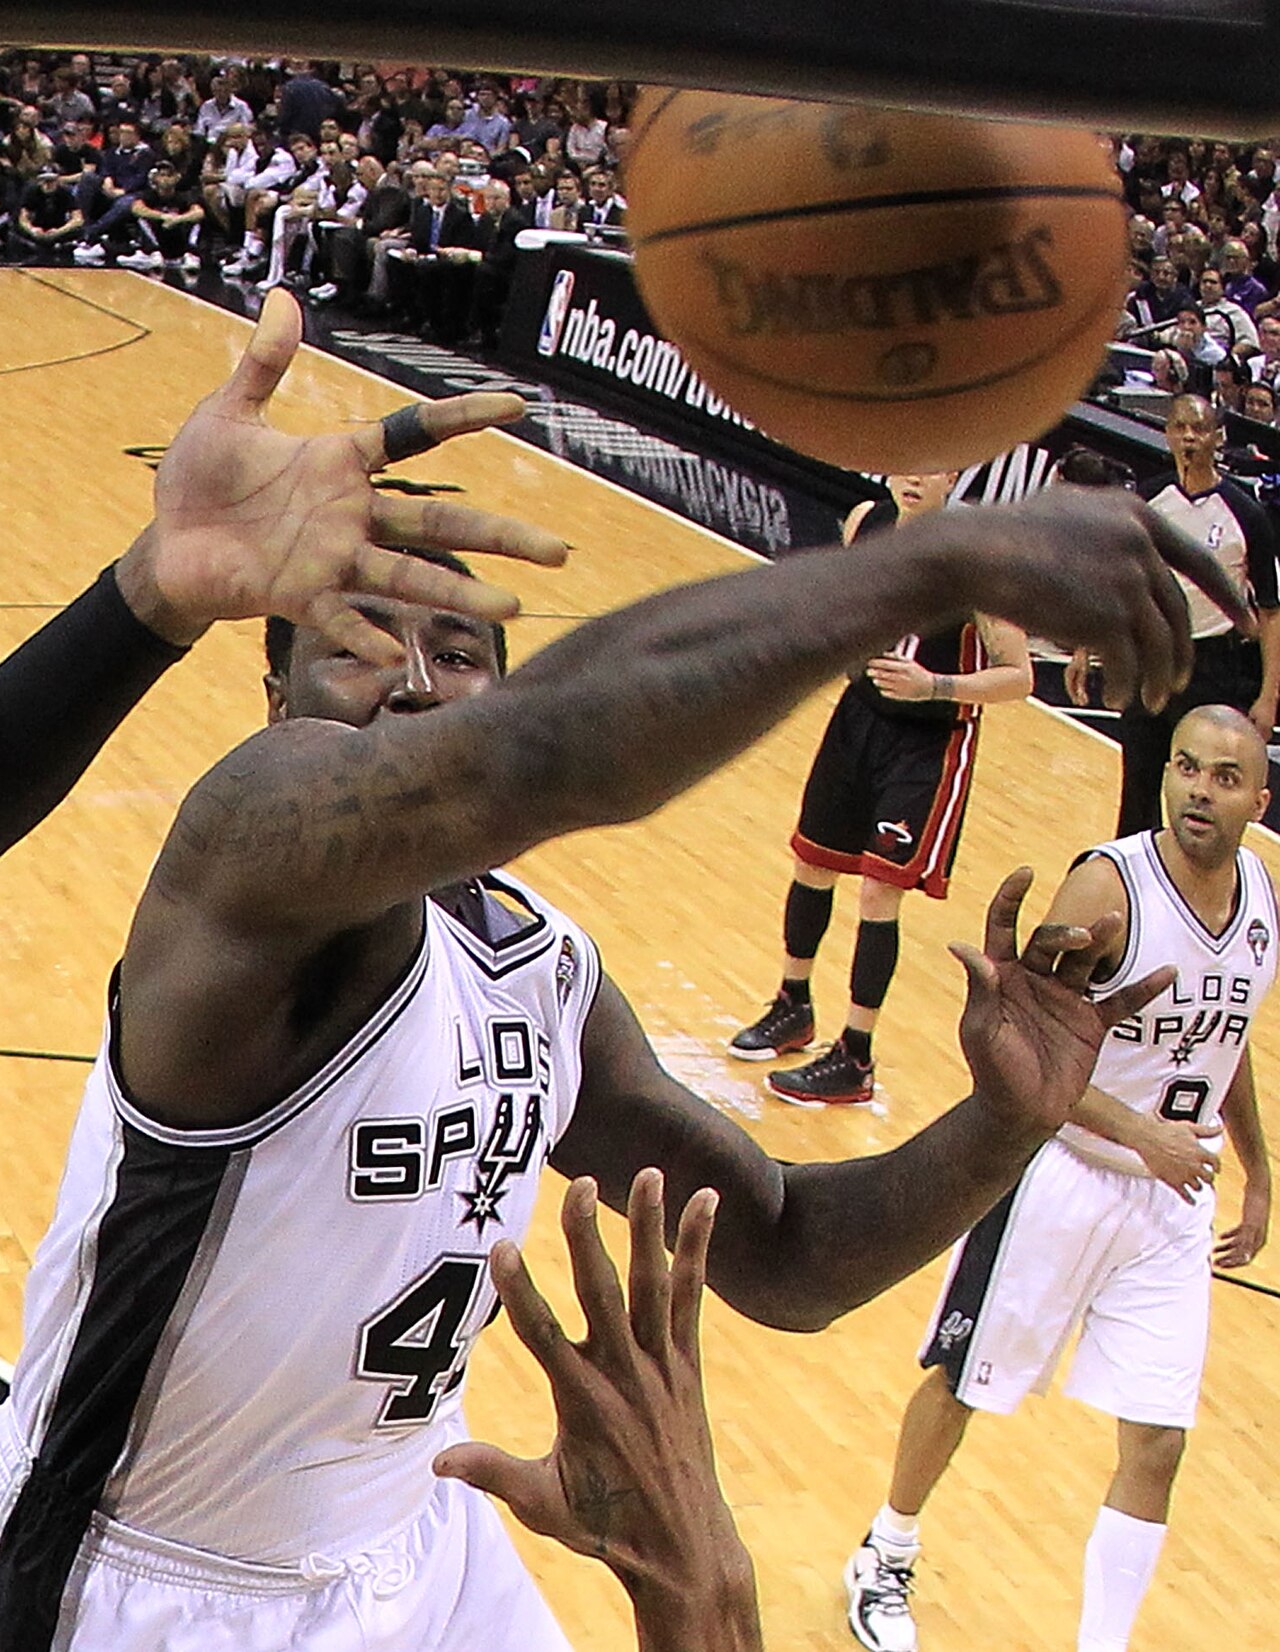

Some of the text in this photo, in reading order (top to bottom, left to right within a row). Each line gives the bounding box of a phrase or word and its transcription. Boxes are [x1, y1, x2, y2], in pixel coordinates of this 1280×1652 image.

[1171, 972, 1253, 1006] LOS
[349, 1092, 553, 1225] SPU
[352, 1251, 504, 1427] 4
